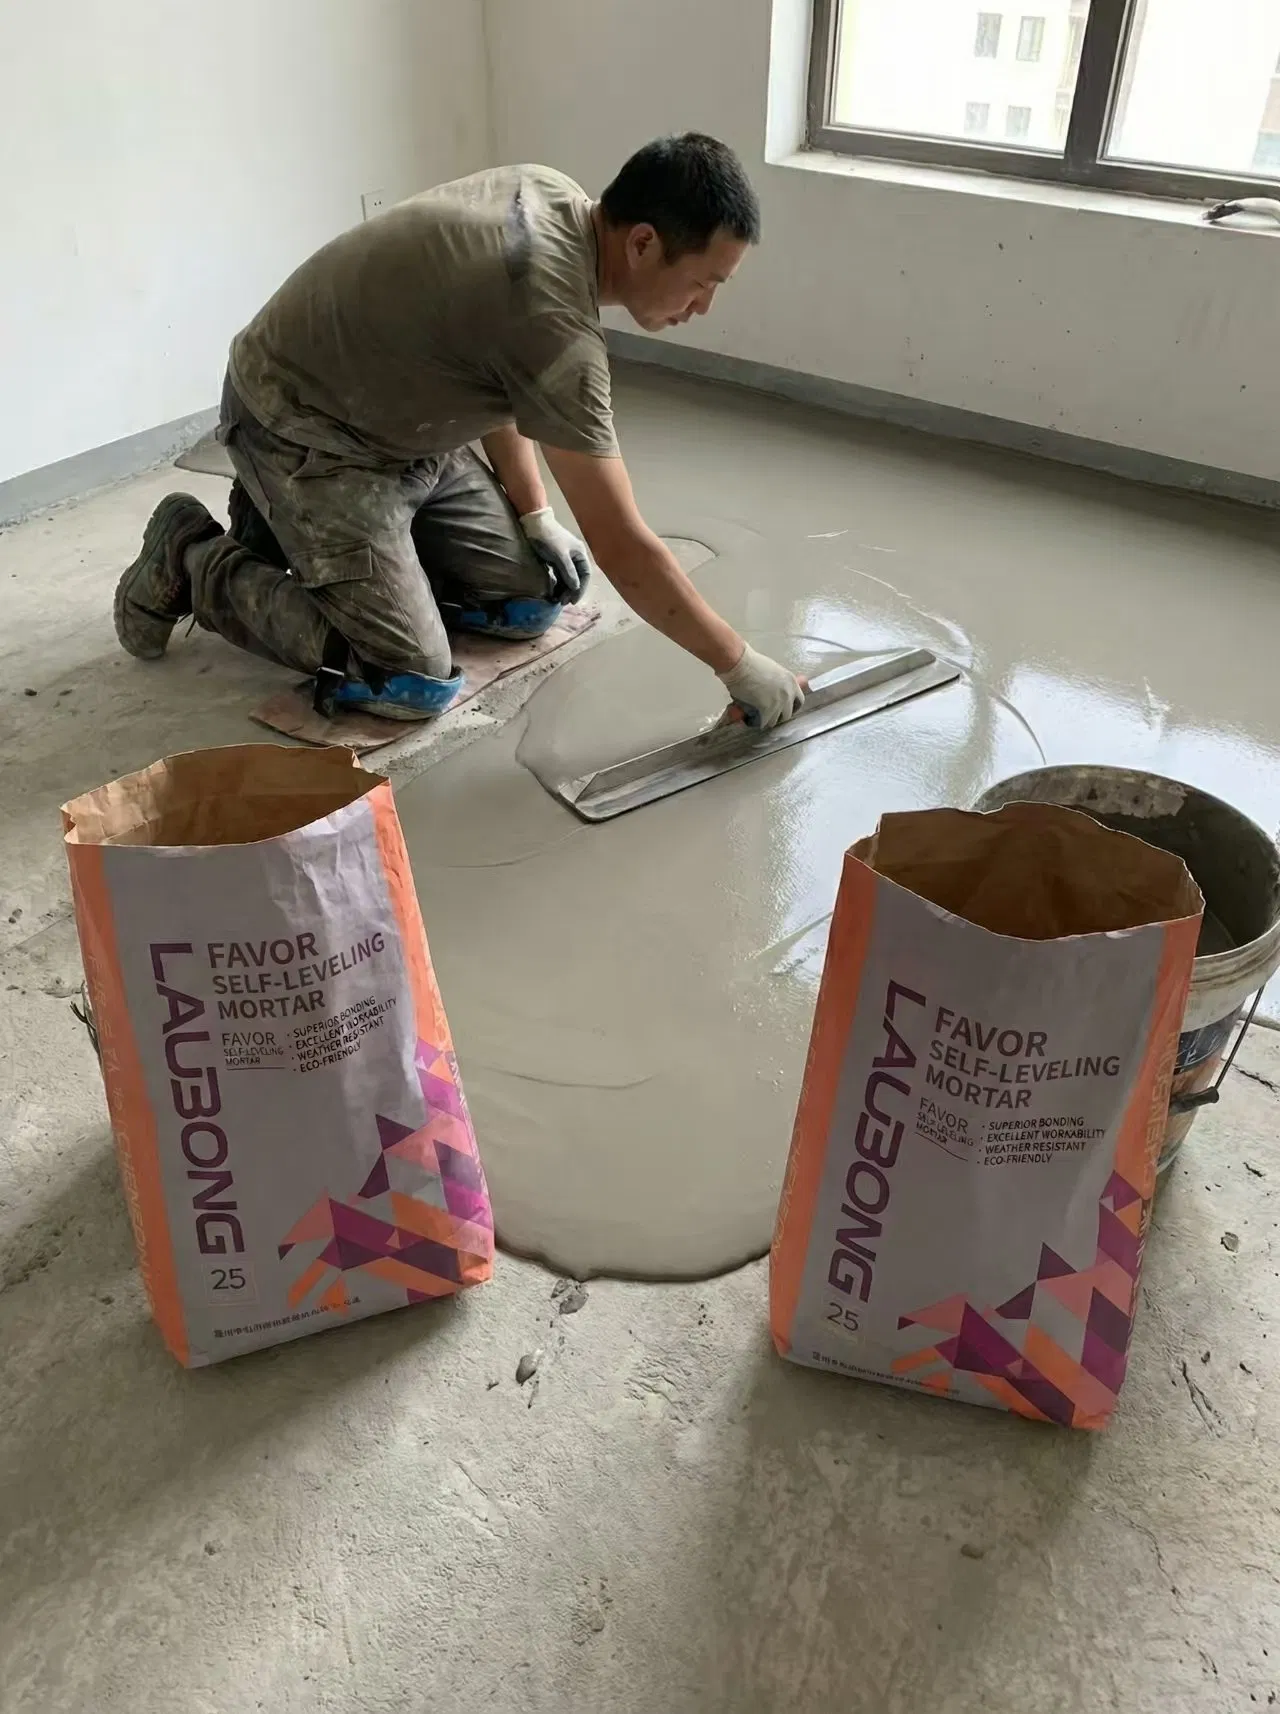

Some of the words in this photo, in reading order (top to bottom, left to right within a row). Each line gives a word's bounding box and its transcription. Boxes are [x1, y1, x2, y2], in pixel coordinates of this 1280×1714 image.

[207, 932, 319, 969] FAVOR
[212, 932, 386, 995] SELF-LEVELING
[217, 990, 326, 1020] MORTAR
[221, 1031, 276, 1047] FAVOR
[293, 1015, 341, 1038] SUPERIOR
[295, 1024, 346, 1050] EXCELLENT
[297, 1040, 344, 1062] WEATHER
[343, 1016, 385, 1047] RESISTANT
[934, 1006, 1048, 1058] FAVOR
[300, 1041, 362, 1073] ECO-FRIENDLY
[928, 1039, 1120, 1084] SELF-LEVELING
[925, 1064, 1032, 1109] MORTAR
[919, 1097, 969, 1134] FAVOR
[988, 1119, 1038, 1131] SUPERIOR
[1038, 1117, 1084, 1128] BONDING
[985, 1142, 1032, 1154] WEATHER
[1032, 1141, 1086, 1152] RESISTANT
[987, 1131, 1041, 1143] EXCELLENT
[983, 1154, 1053, 1166] ECO-FRIENDLY
[211, 1267, 246, 1291] 25
[826, 1301, 860, 1332] 25
